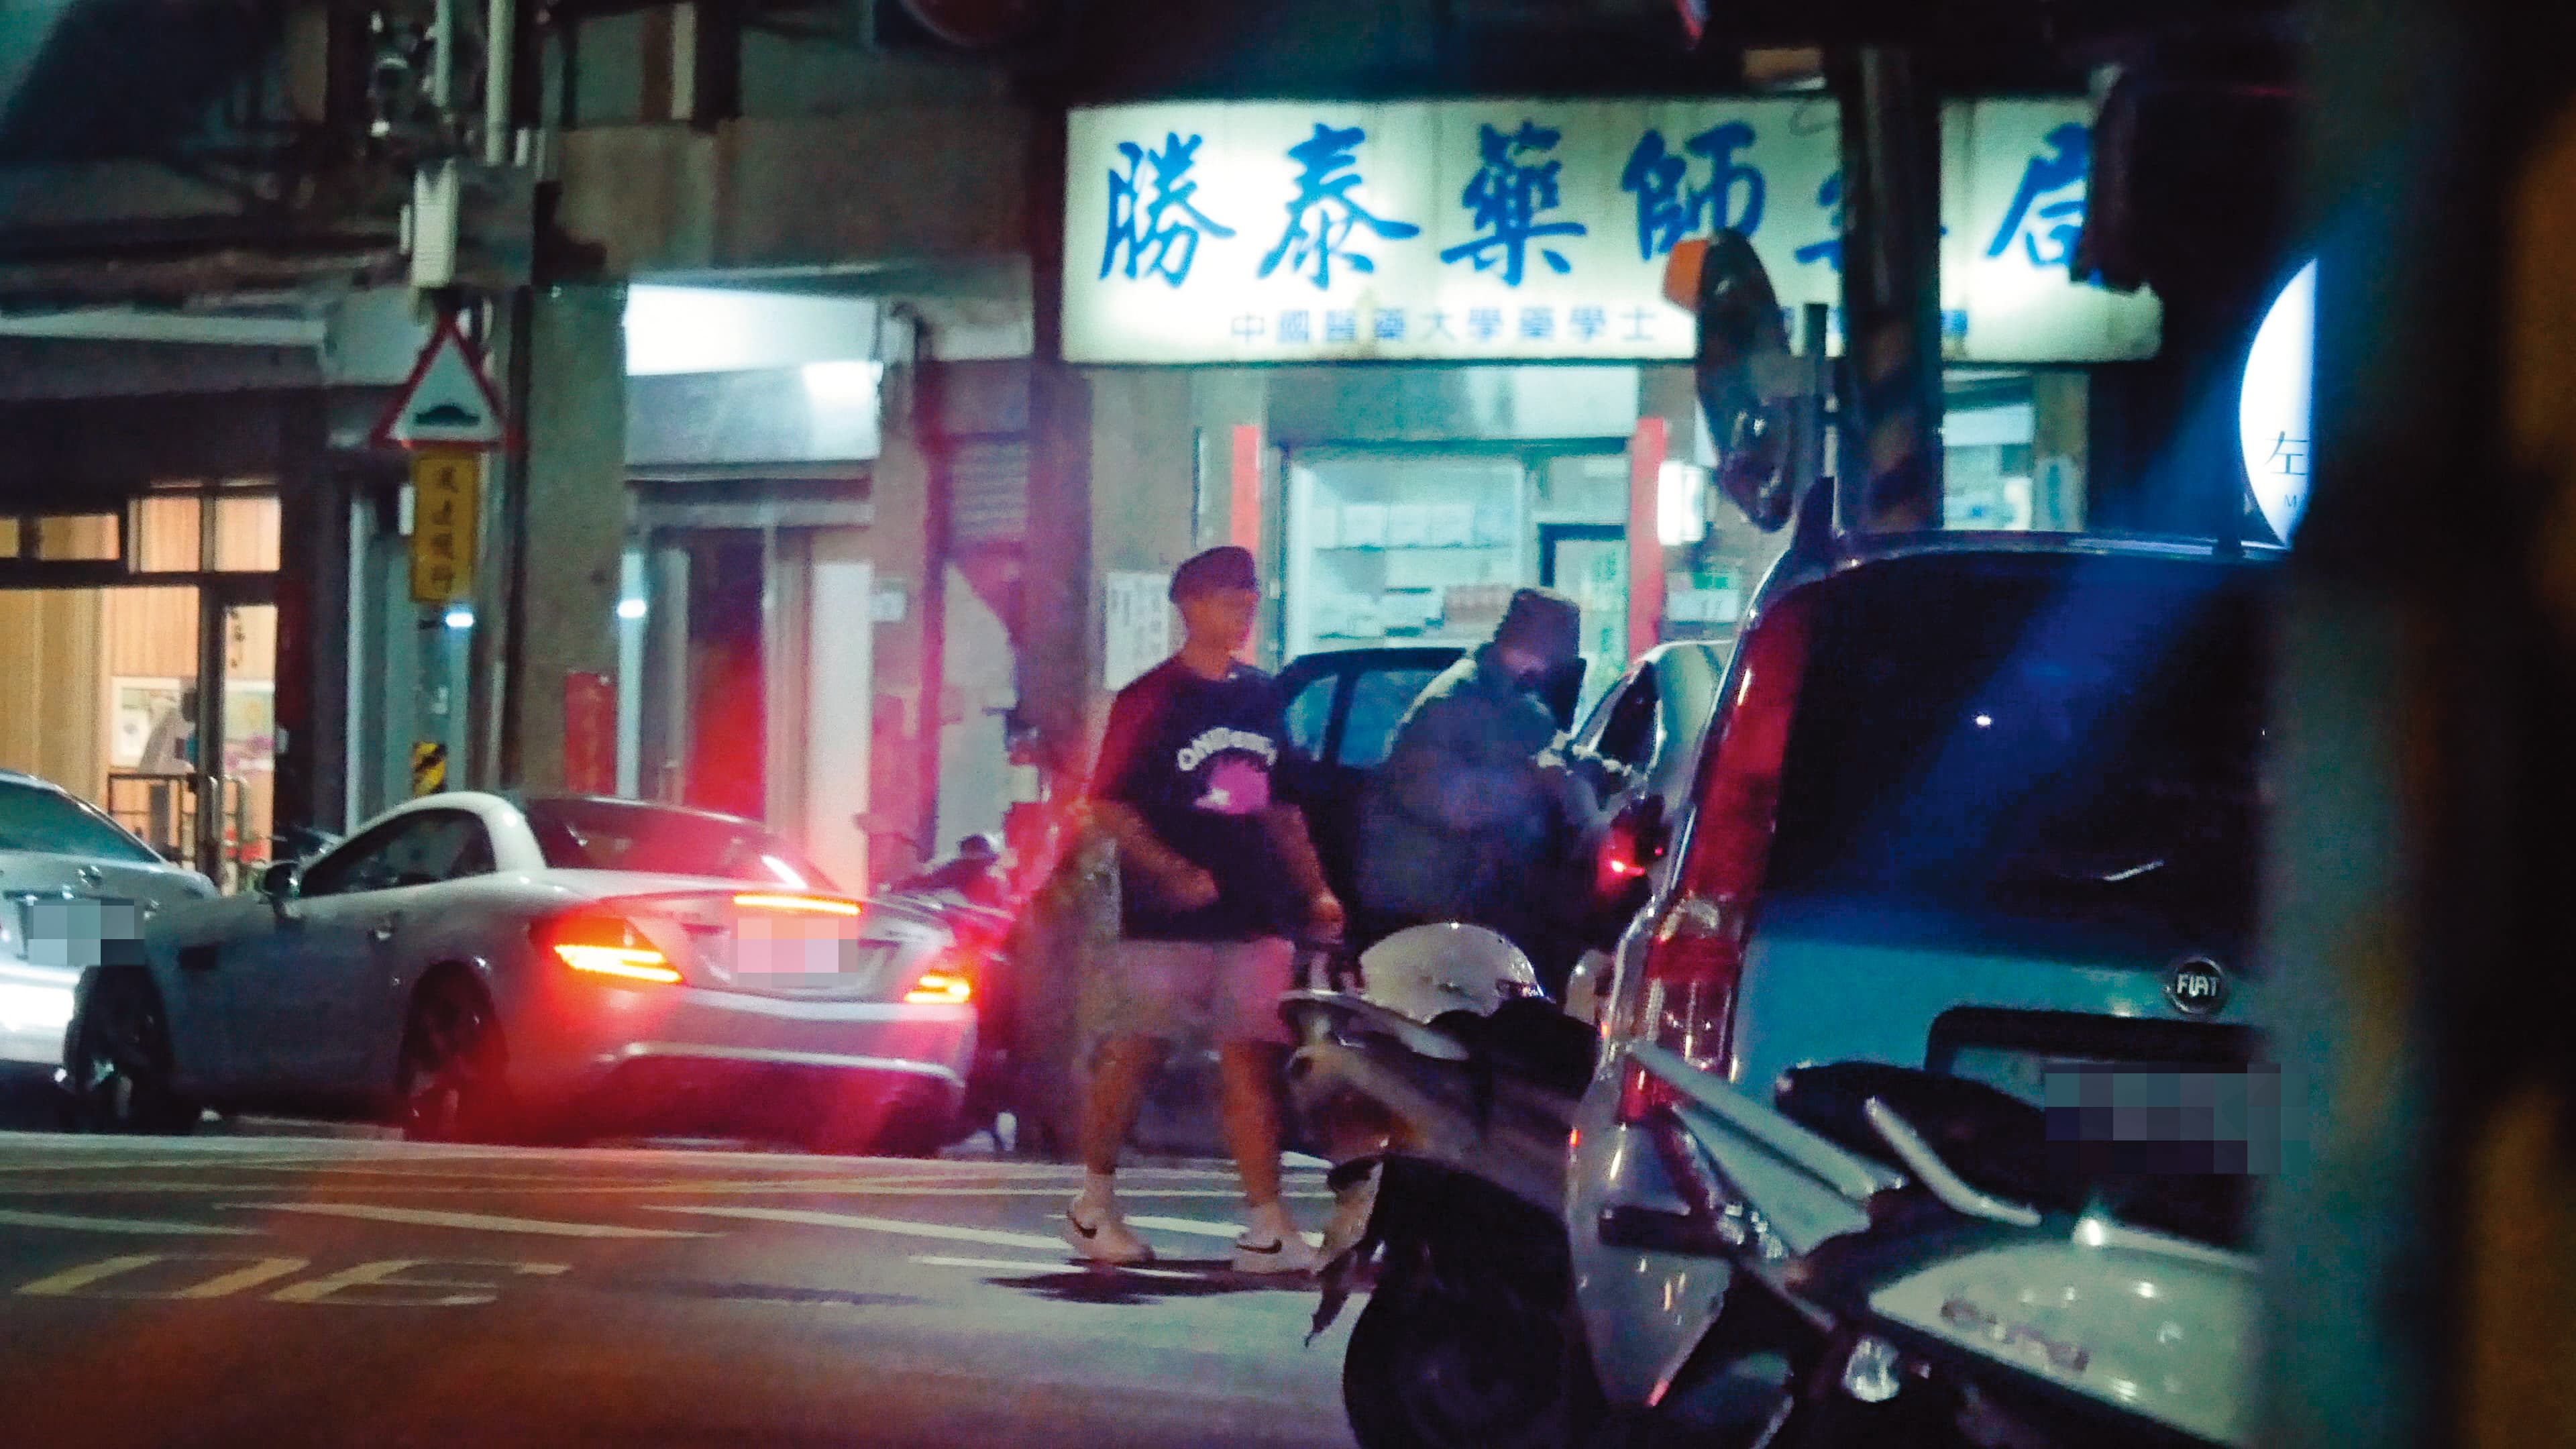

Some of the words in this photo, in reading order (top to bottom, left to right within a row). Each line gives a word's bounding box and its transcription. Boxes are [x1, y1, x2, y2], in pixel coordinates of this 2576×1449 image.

[1099, 119, 2104, 288] 勝泰藥師局
[2263, 431, 2310, 476] 左
[2176, 973, 2218, 998] FIAT
